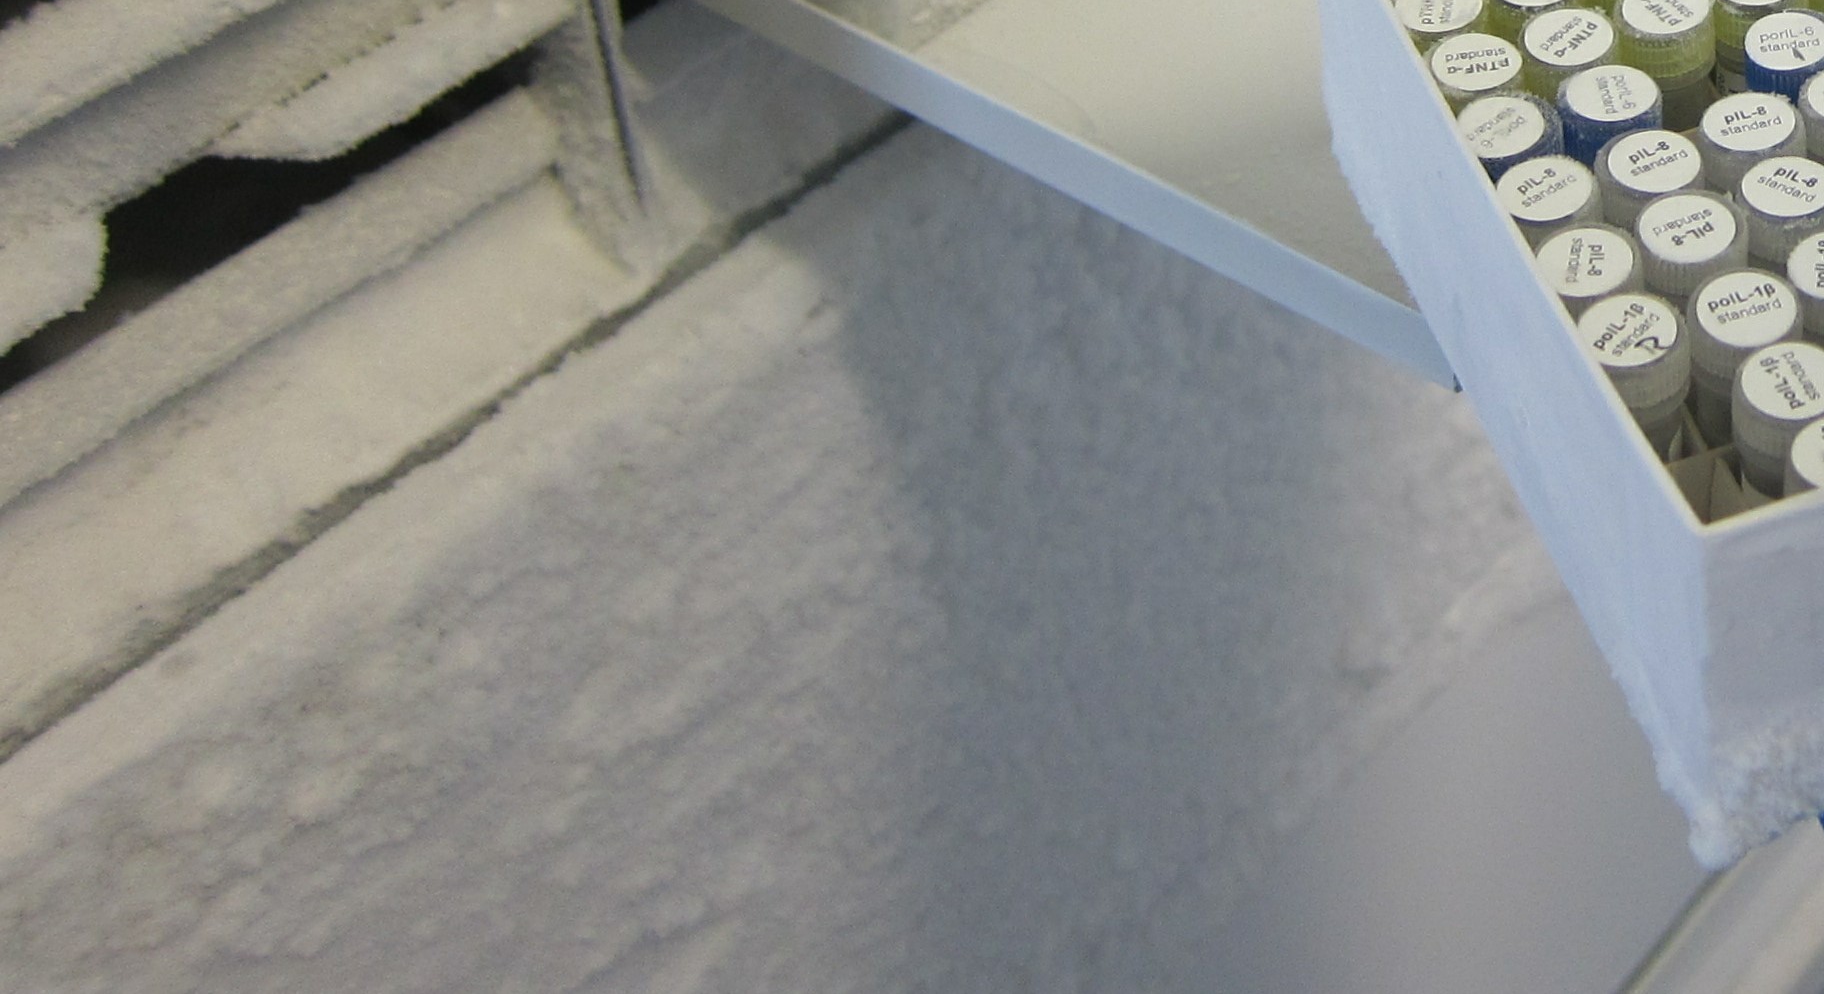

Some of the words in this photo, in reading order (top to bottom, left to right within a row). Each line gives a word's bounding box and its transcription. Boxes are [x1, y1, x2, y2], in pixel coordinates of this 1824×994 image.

[1540, 15, 1583, 52] standard
[1760, 36, 1820, 53] standard
[1444, 47, 1507, 63] standard
[1595, 76, 1618, 115] standard
[1720, 116, 1783, 137] standard
[1724, 106, 1768, 125] pIL-8
[1628, 141, 1670, 165] pIL-8
[1630, 149, 1688, 177] standard
[1517, 167, 1557, 194] pIL-8
[1521, 174, 1576, 208] standard
[1757, 175, 1817, 204] standard
[1774, 166, 1818, 188] pIL-8
[1653, 208, 1713, 237] standard
[1671, 221, 1715, 246] pIL-8
[1566, 237, 1583, 283] standard
[1587, 244, 1605, 276] pIL-8
[1717, 298, 1782, 324] standard
[1612, 313, 1661, 357] standard
[1782, 351, 1820, 400] standard
